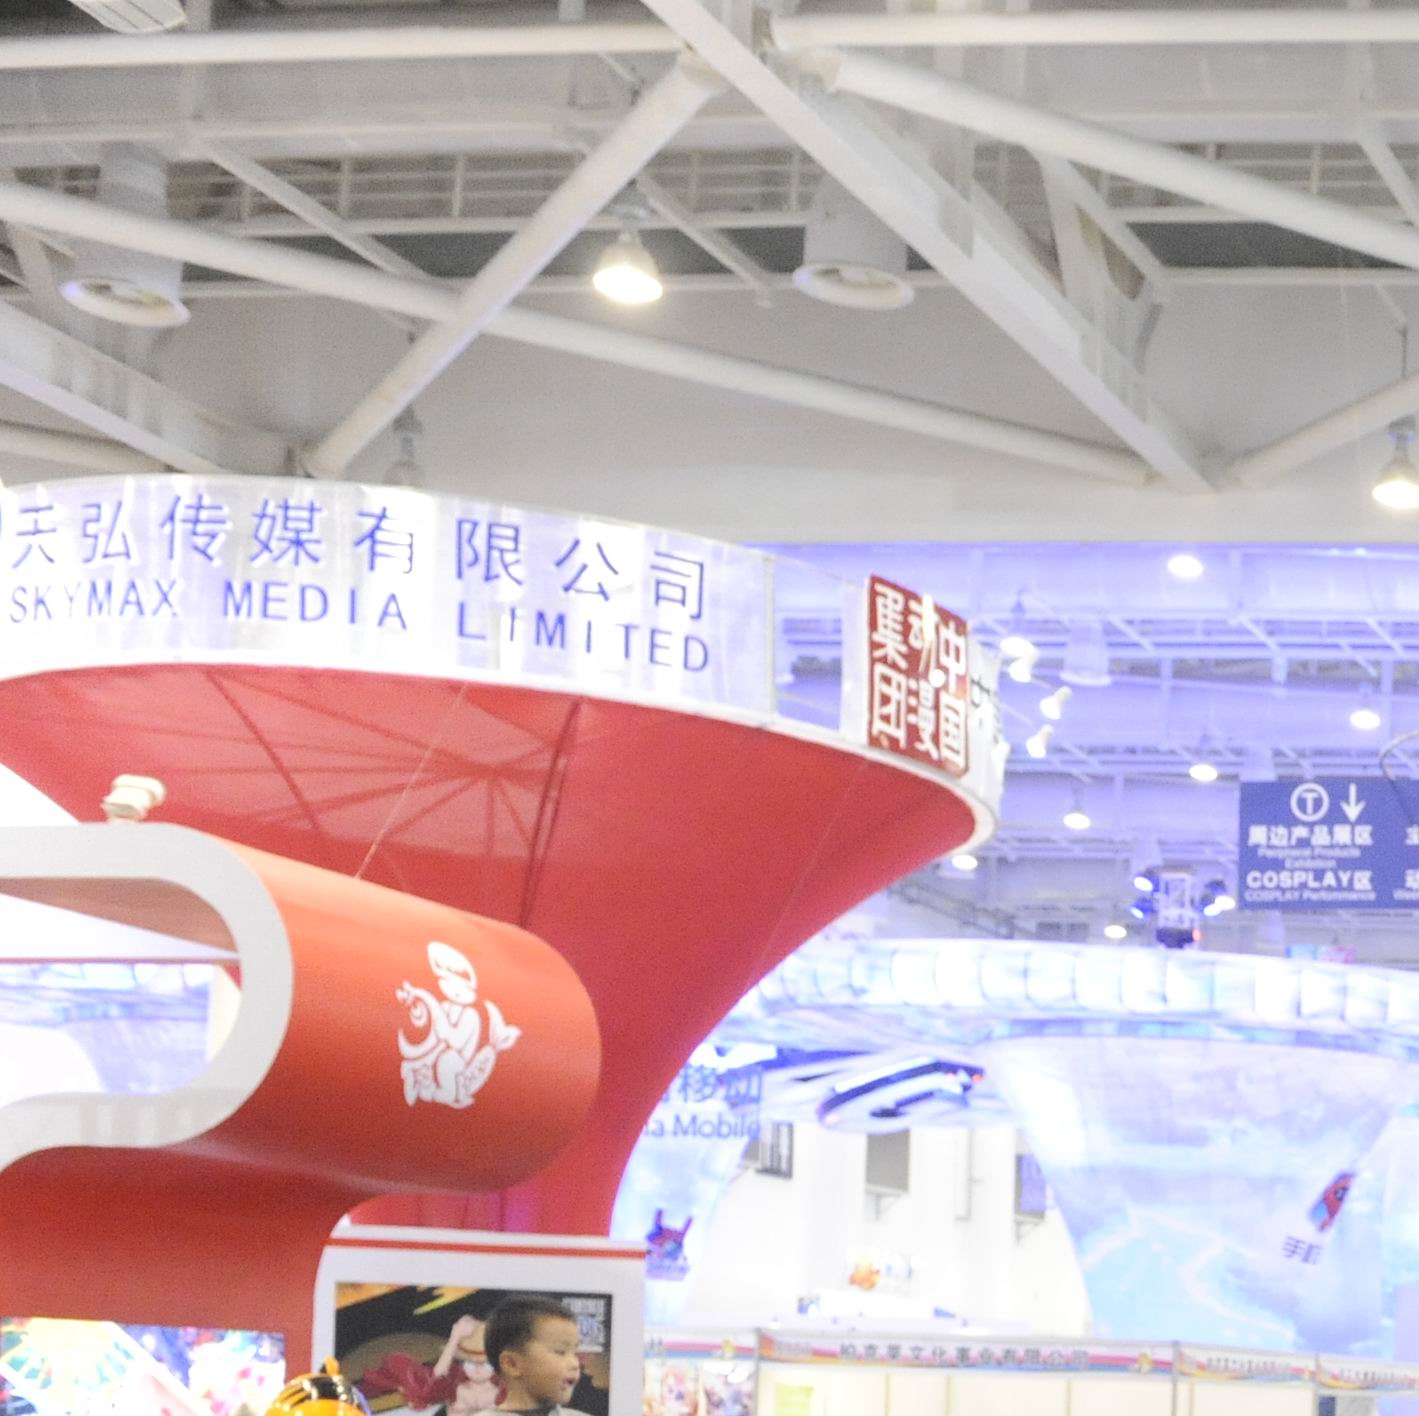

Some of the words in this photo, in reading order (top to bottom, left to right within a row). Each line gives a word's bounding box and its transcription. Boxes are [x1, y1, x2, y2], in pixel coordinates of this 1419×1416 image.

[10, 578, 180, 623] SKYMAX
[222, 579, 407, 630] MEDIA
[458, 600, 709, 672] LIMITED
[672, 1112, 761, 1138] Mobile
